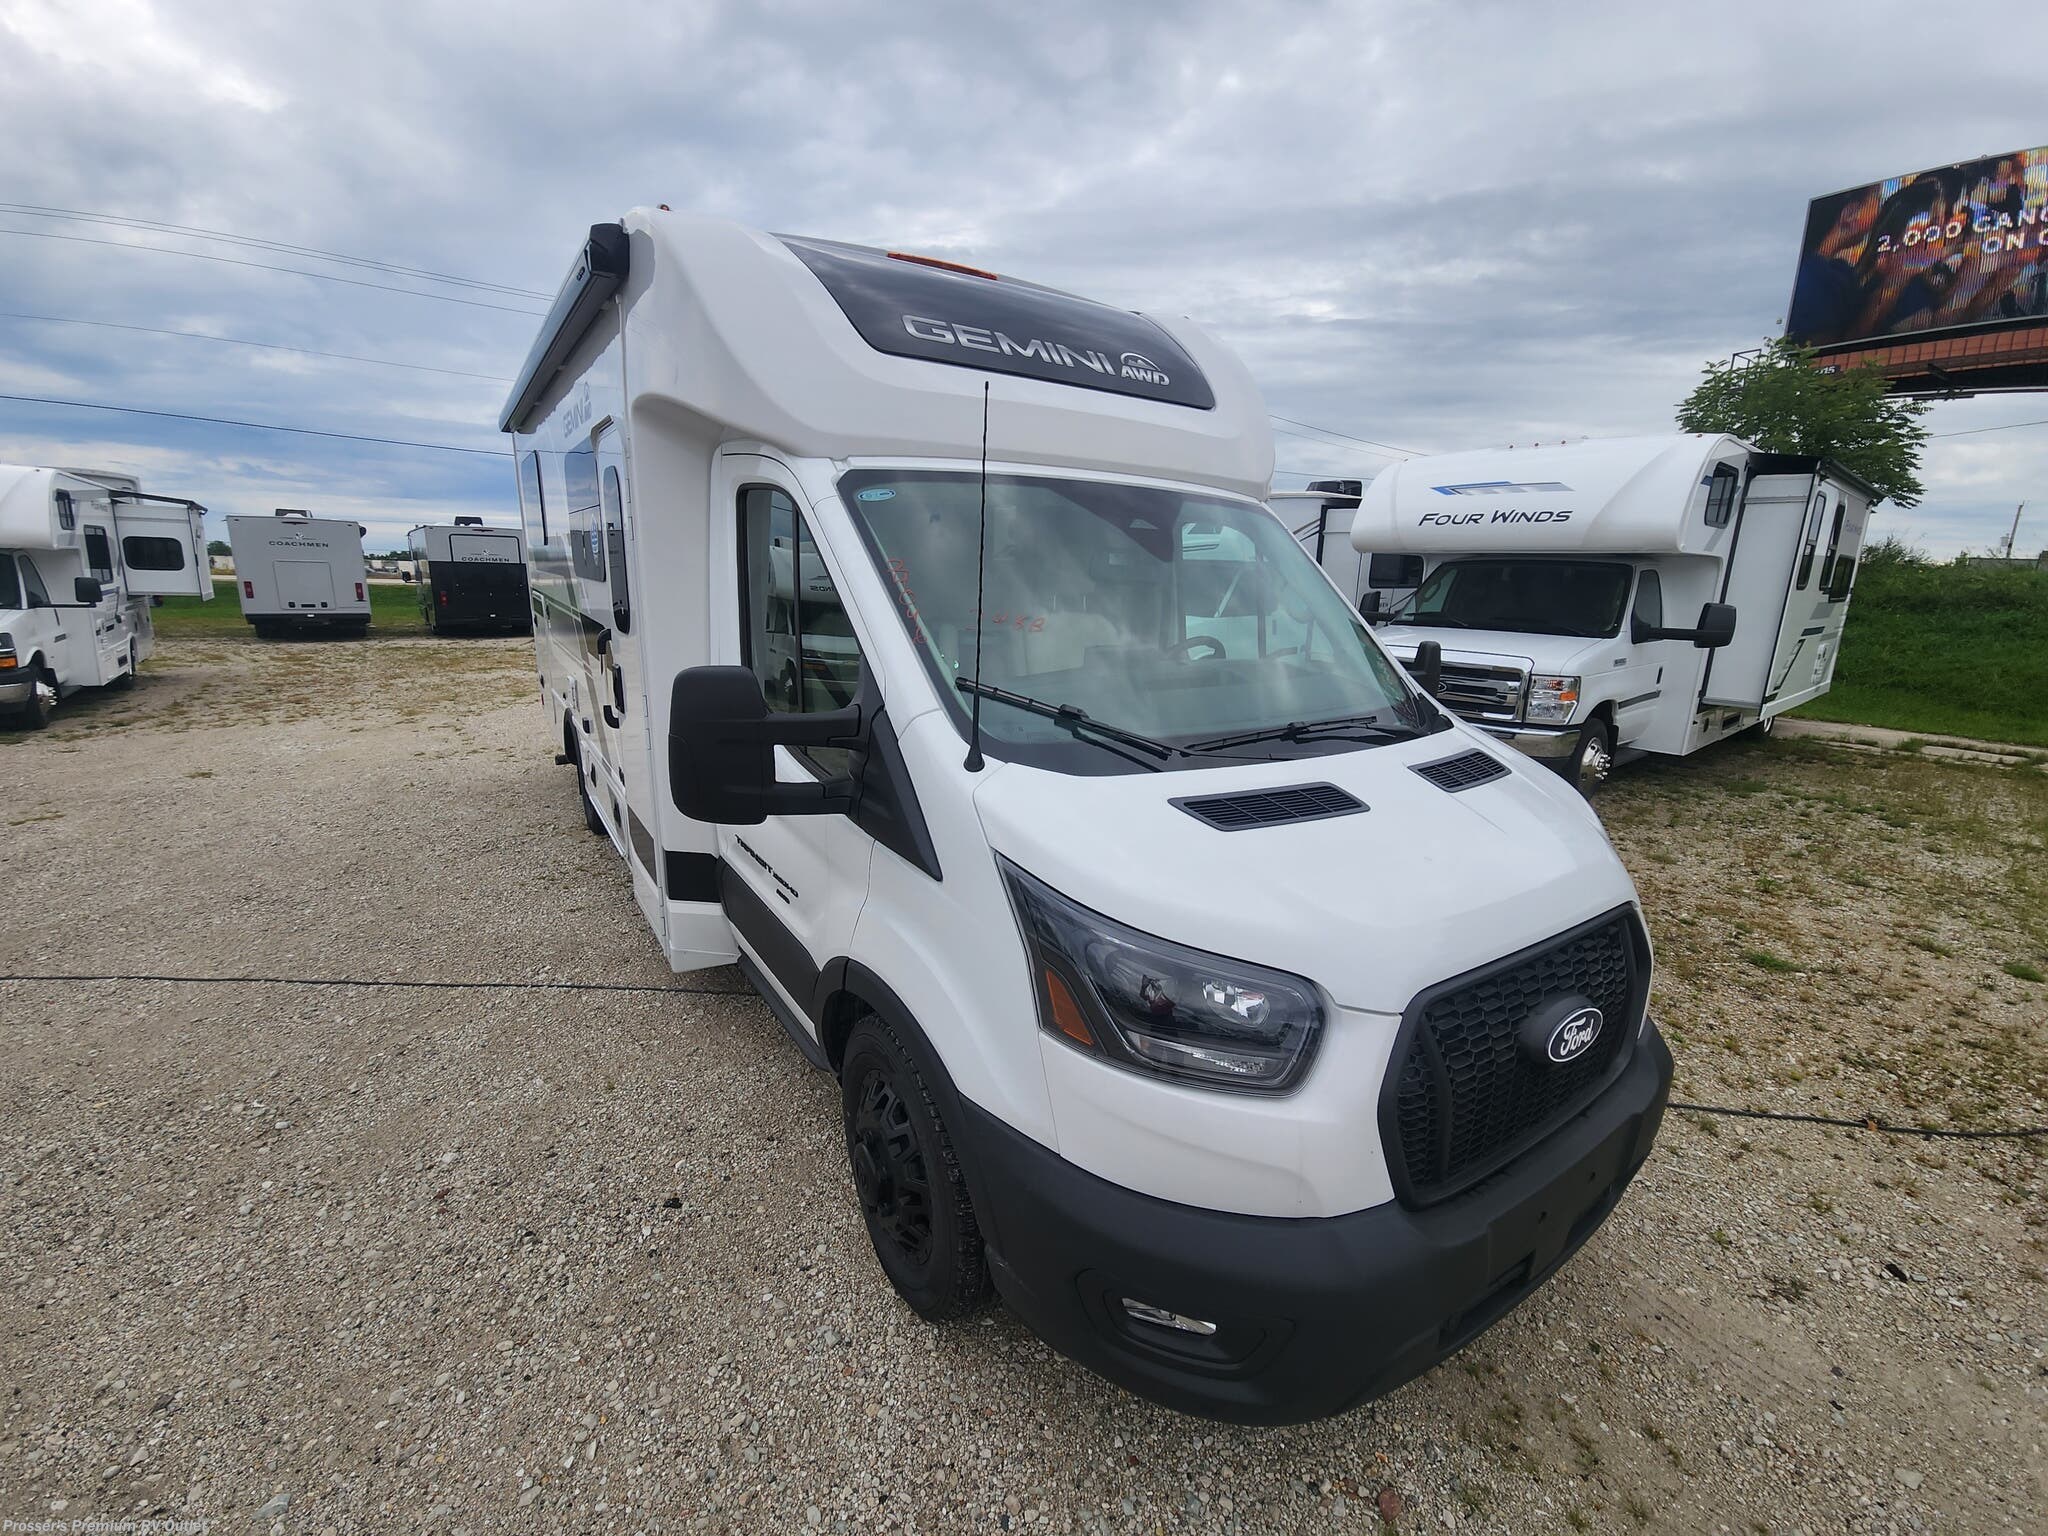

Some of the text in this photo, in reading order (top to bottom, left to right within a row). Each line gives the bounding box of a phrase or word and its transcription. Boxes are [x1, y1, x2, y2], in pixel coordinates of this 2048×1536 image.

[1877, 221, 1962, 252] 2,000
[1982, 232, 2025, 253] ON
[901, 314, 1171, 387] GEMINI AWD
[1418, 509, 1574, 527] FOUR WINDS
[268, 540, 329, 548] COACHMEN
[1560, 1016, 1595, 1057] Ford
